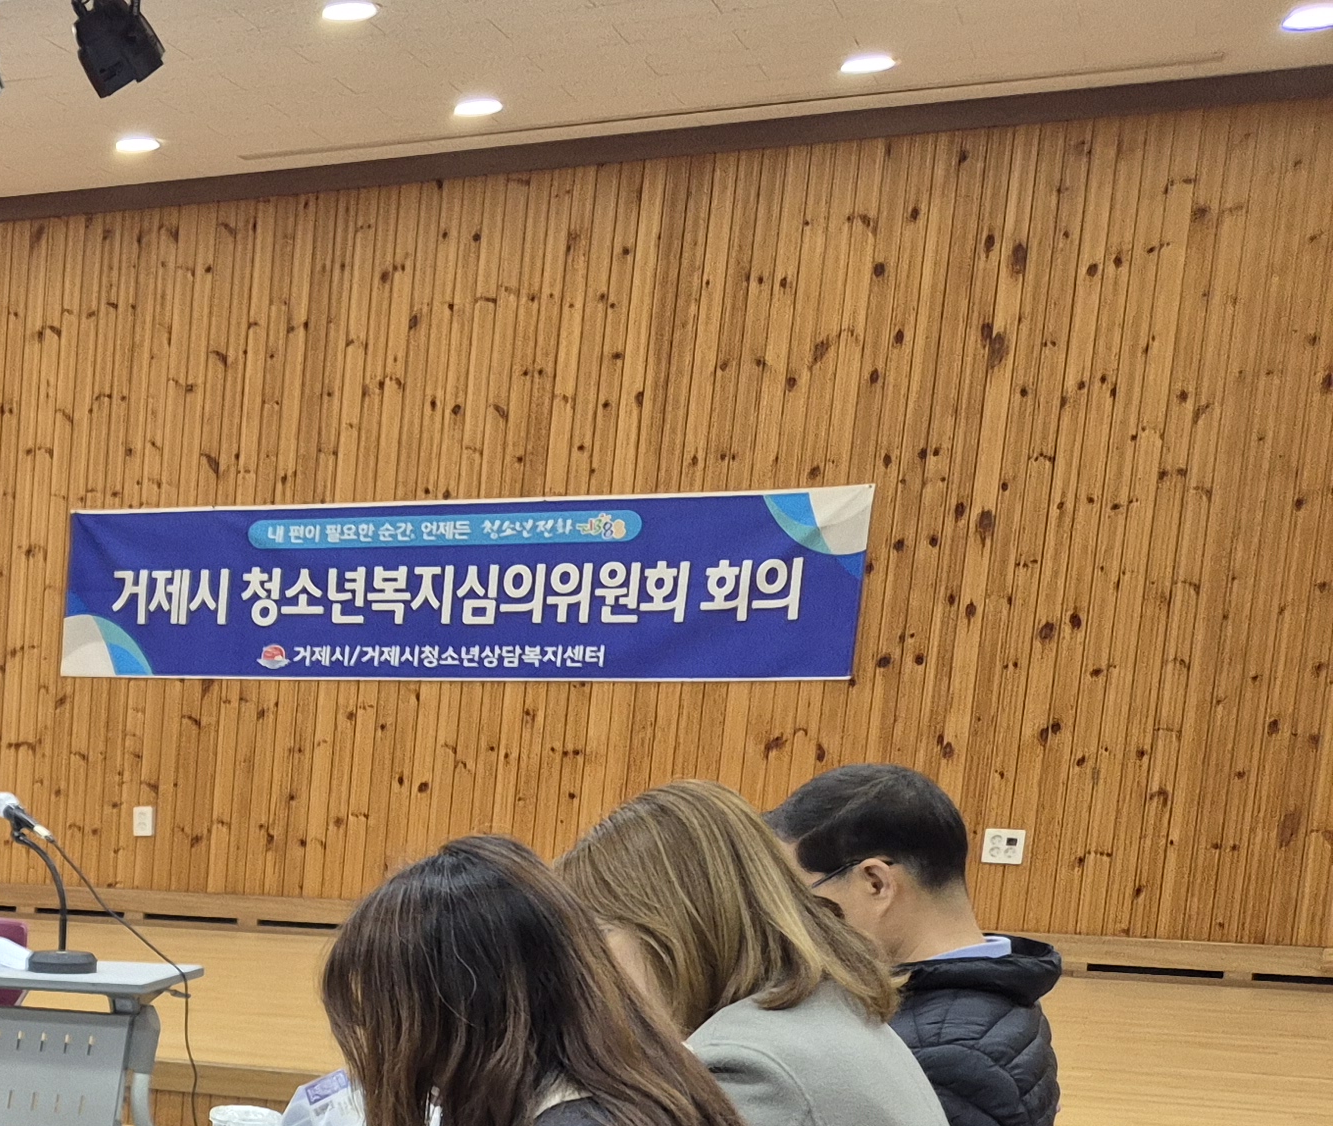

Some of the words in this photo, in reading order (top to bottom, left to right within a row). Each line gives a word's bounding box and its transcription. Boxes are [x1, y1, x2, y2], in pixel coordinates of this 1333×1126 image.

[267, 525, 285, 543] 내
[289, 525, 320, 543] 편이
[325, 522, 375, 543] 필요한
[421, 520, 471, 541] 언제든
[112, 566, 226, 626] 거제시
[241, 558, 690, 629] 청소년복지심의위원회
[699, 555, 803, 623] 회의
[293, 645, 605, 668] 거제시/거제시청소년상담복지센터
